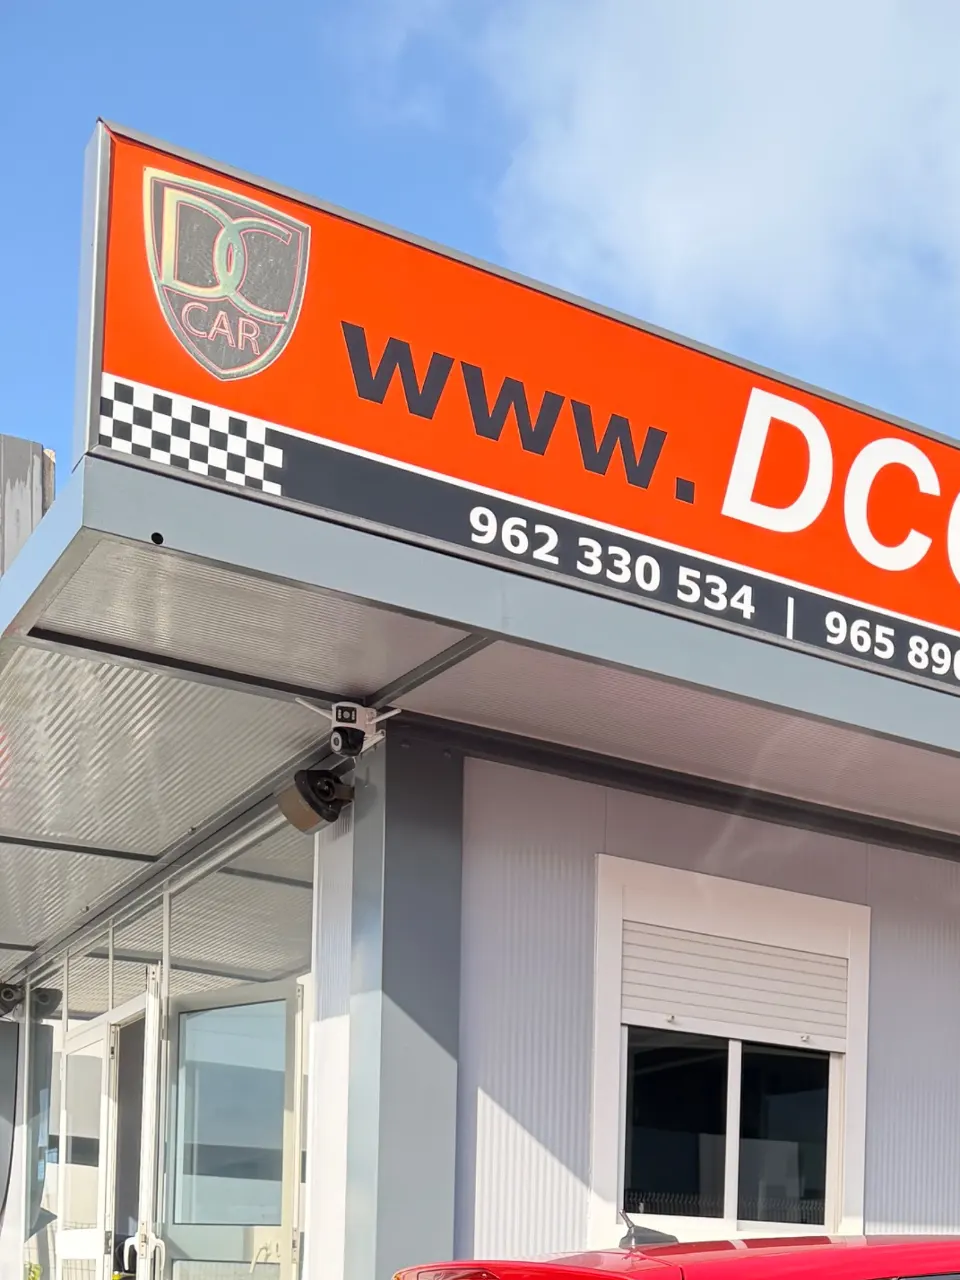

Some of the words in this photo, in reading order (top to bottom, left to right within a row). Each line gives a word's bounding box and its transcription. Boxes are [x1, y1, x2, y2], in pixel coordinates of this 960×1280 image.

[180, 301, 261, 356] CAR
[468, 505, 560, 564] 962
[575, 536, 660, 593] 330
[676, 567, 756, 620] 534
[824, 610, 896, 660] 965
